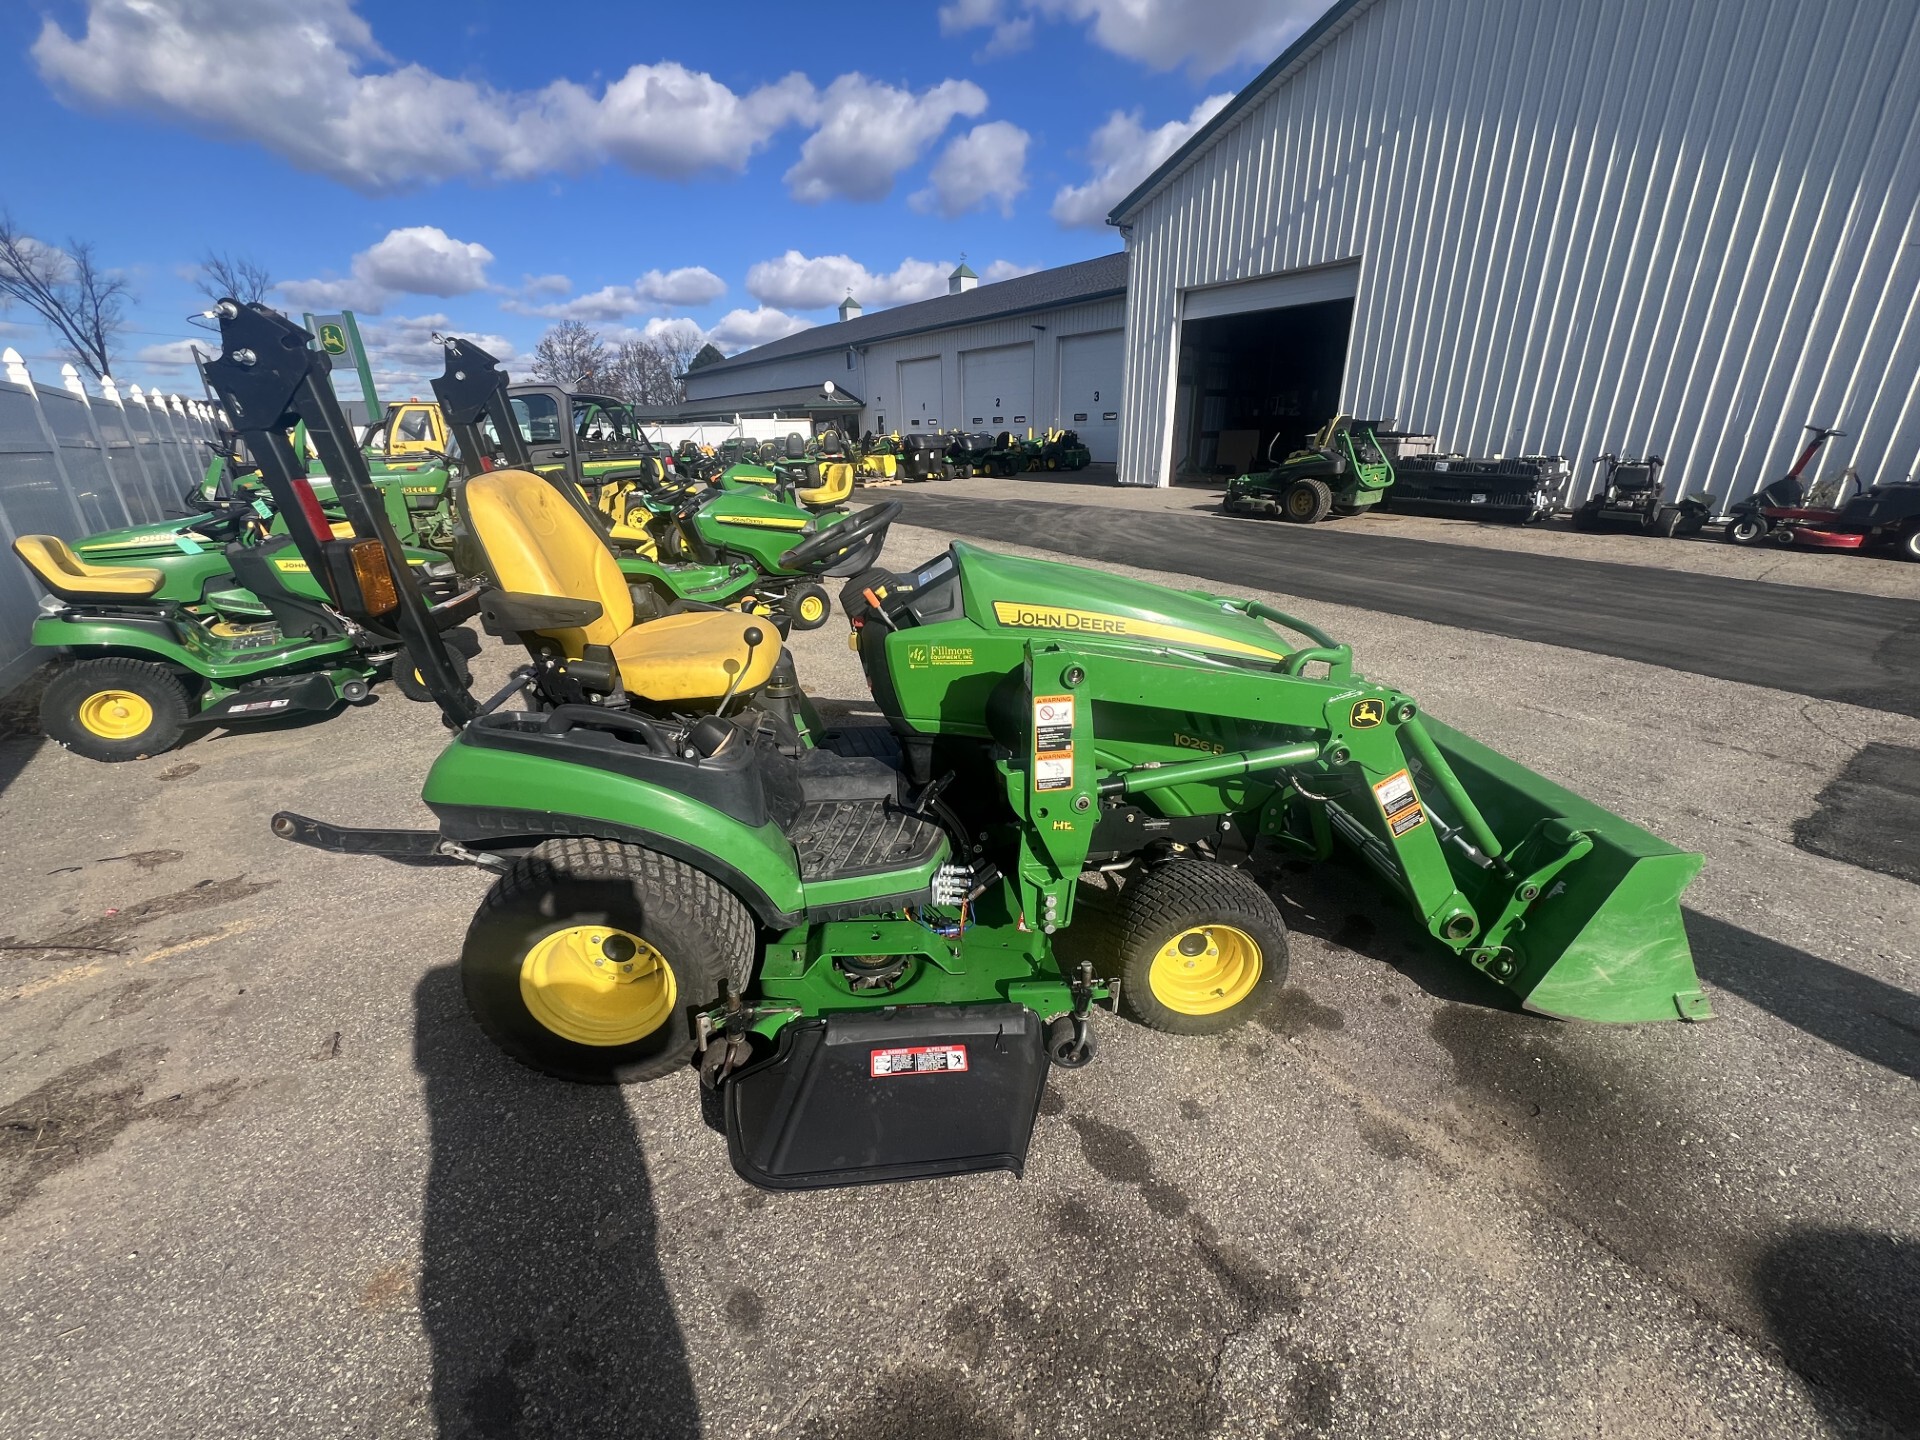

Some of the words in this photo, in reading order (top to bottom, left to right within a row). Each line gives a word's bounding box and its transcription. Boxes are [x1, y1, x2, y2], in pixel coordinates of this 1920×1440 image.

[1093, 391, 1100, 402] 3
[922, 402, 926, 410] 1
[995, 398, 1000, 407] 2
[1011, 609, 1061, 627] JOHN
[1065, 613, 1126, 633] DEERE
[931, 645, 973, 655] Fillmore
